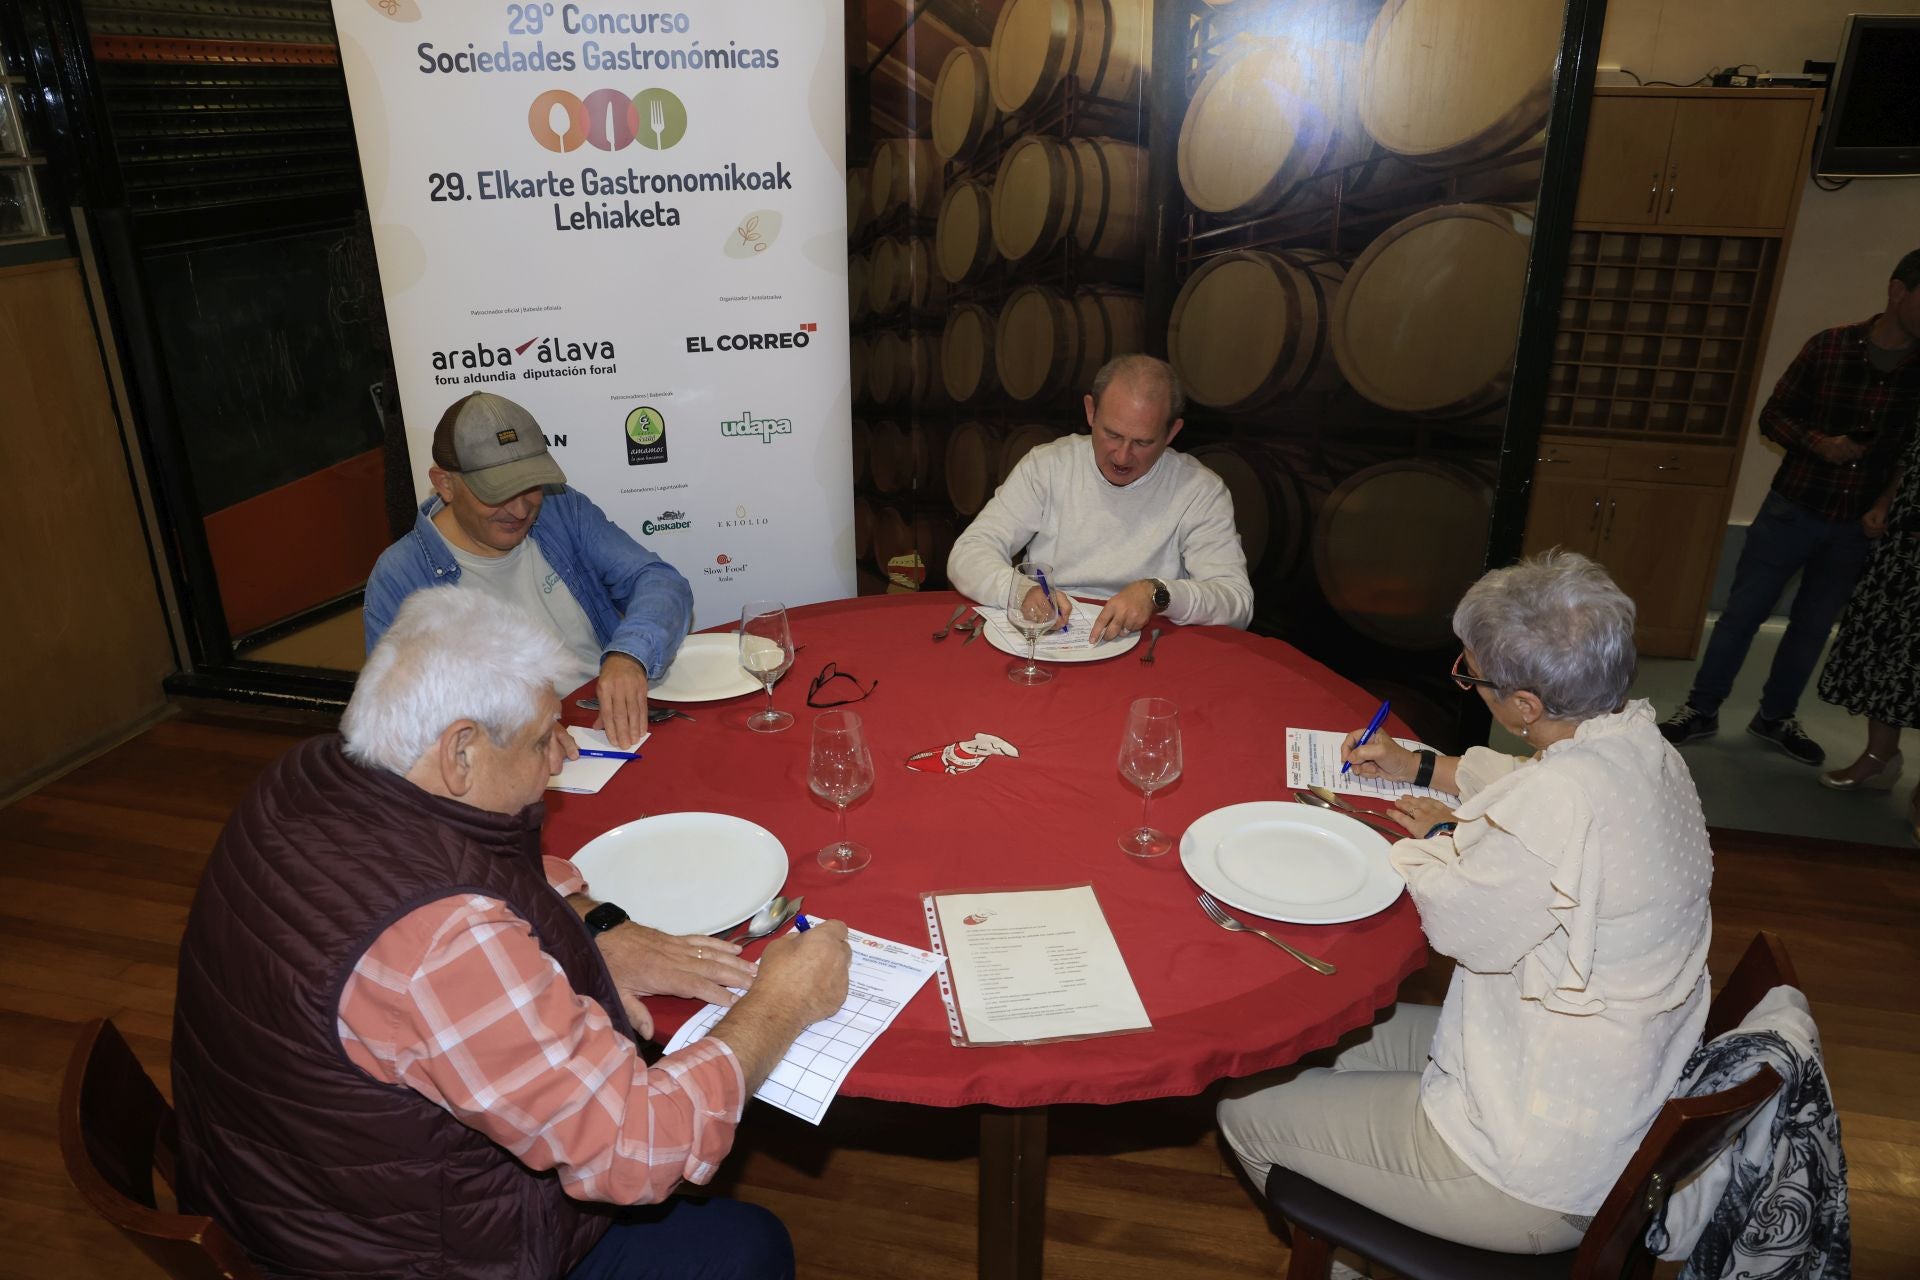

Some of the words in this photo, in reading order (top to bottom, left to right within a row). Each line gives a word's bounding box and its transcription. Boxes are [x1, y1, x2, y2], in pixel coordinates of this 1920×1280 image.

[562, 3, 690, 35] Concurso
[417, 41, 577, 74] Sociedades
[582, 40, 779, 71] Gastronómicas
[428, 171, 473, 202] 29.
[477, 168, 575, 199] Elkarte
[581, 161, 792, 196] Gastronomikoak
[554, 200, 681, 231] Lehiaketa
[432, 342, 513, 370] araba
[537, 337, 615, 363] álava
[686, 336, 714, 353] EL
[717, 332, 809, 351] CORREO
[435, 374, 460, 385] foru
[463, 370, 516, 383] aldundia
[523, 365, 587, 380] diputación
[590, 363, 617, 375] foral
[721, 411, 792, 444] udapa
[703, 567, 723, 576] Slow
